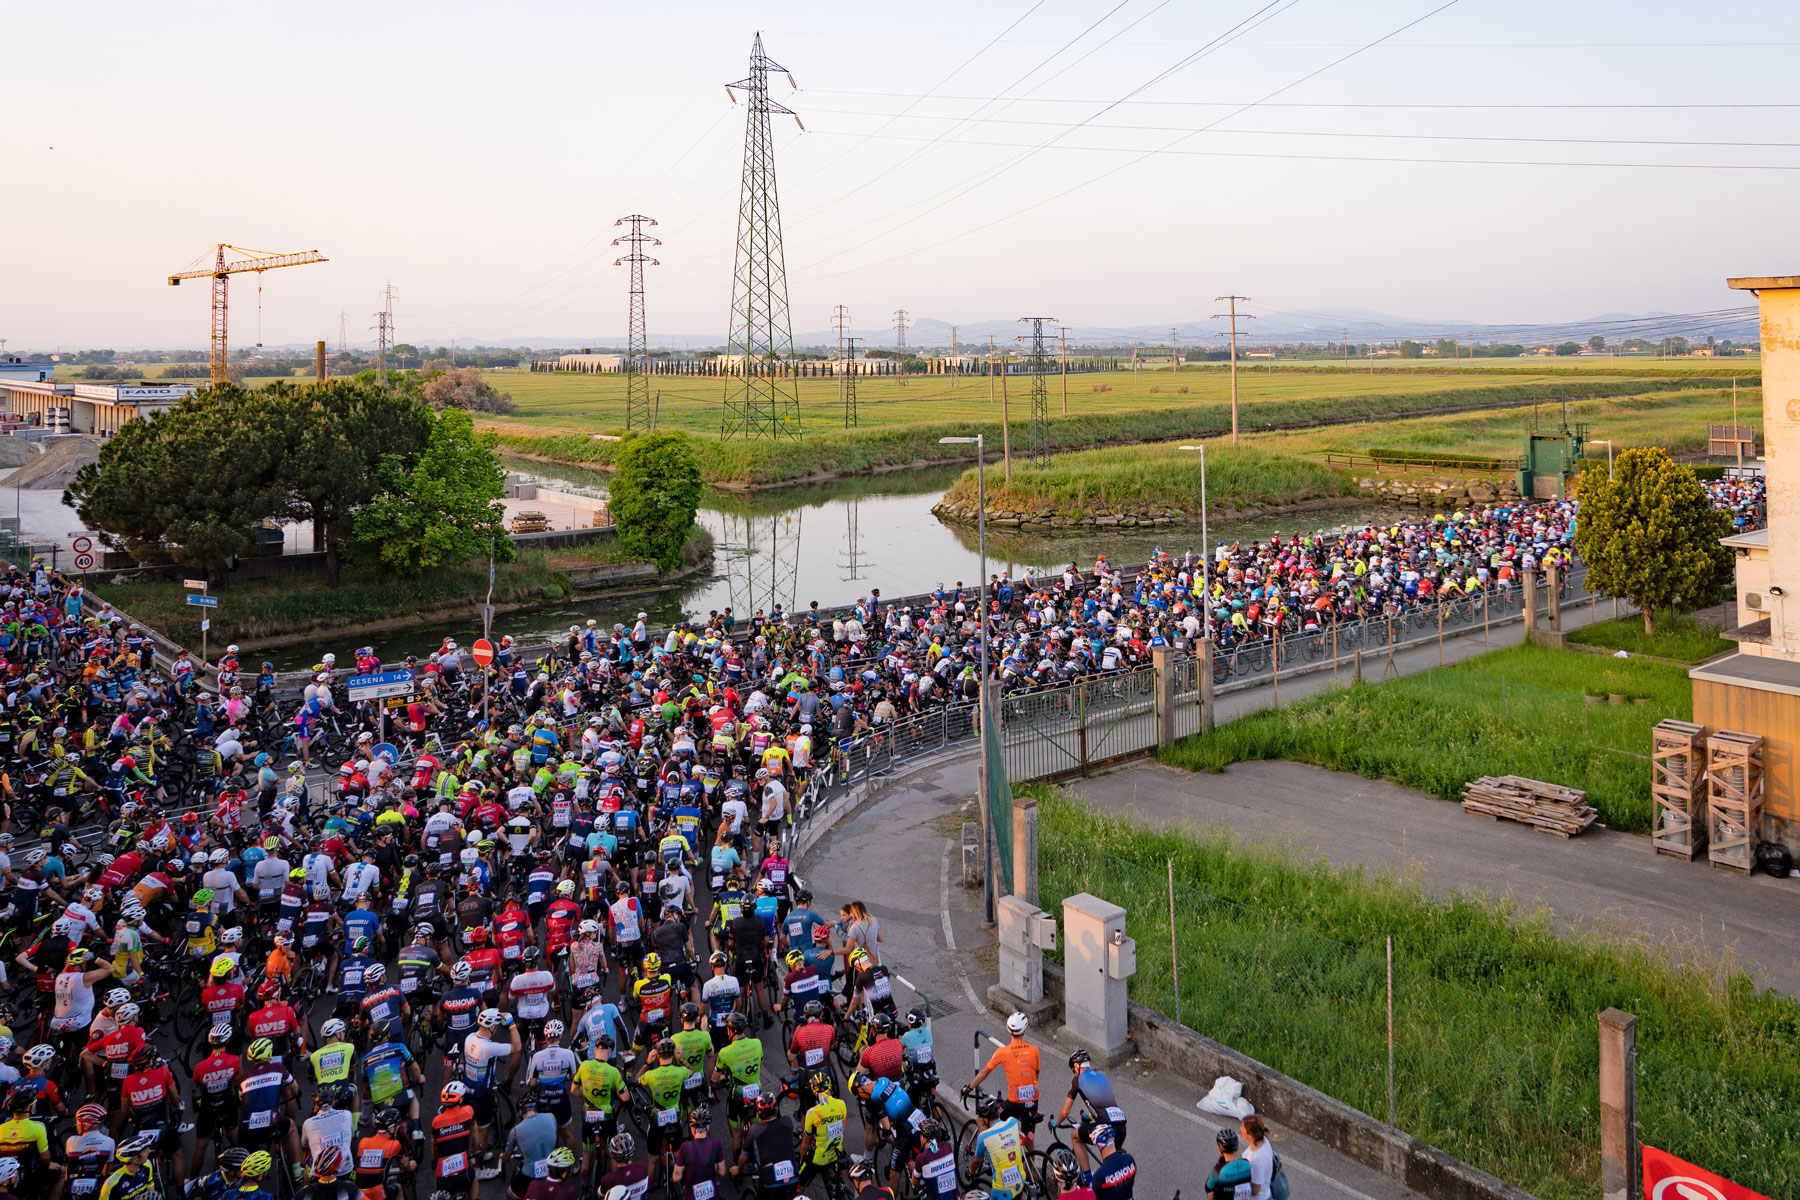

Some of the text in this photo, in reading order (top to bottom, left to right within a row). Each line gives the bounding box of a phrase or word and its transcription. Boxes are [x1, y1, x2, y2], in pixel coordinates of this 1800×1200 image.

[78, 557, 90, 566] 40
[350, 676, 384, 686] CESENA
[362, 986, 396, 1005] GENOVA
[207, 997, 236, 1010] AVIS
[255, 1020, 286, 1034] AVIS
[106, 1042, 129, 1055] AVIS
[687, 1054, 702, 1065] GC
[320, 1069, 343, 1080] VIVOLO
[744, 1063, 759, 1075] GC
[202, 1067, 235, 1084] AVIS
[244, 1076, 279, 1089] NOVECOLLI
[130, 1083, 163, 1102] AVIS
[591, 1087, 608, 1097] GC
[662, 1089, 679, 1101] GC
[250, 1115, 270, 1126] 04205
[361, 1155, 381, 1164] 03277
[695, 1187, 714, 1199] 03634
